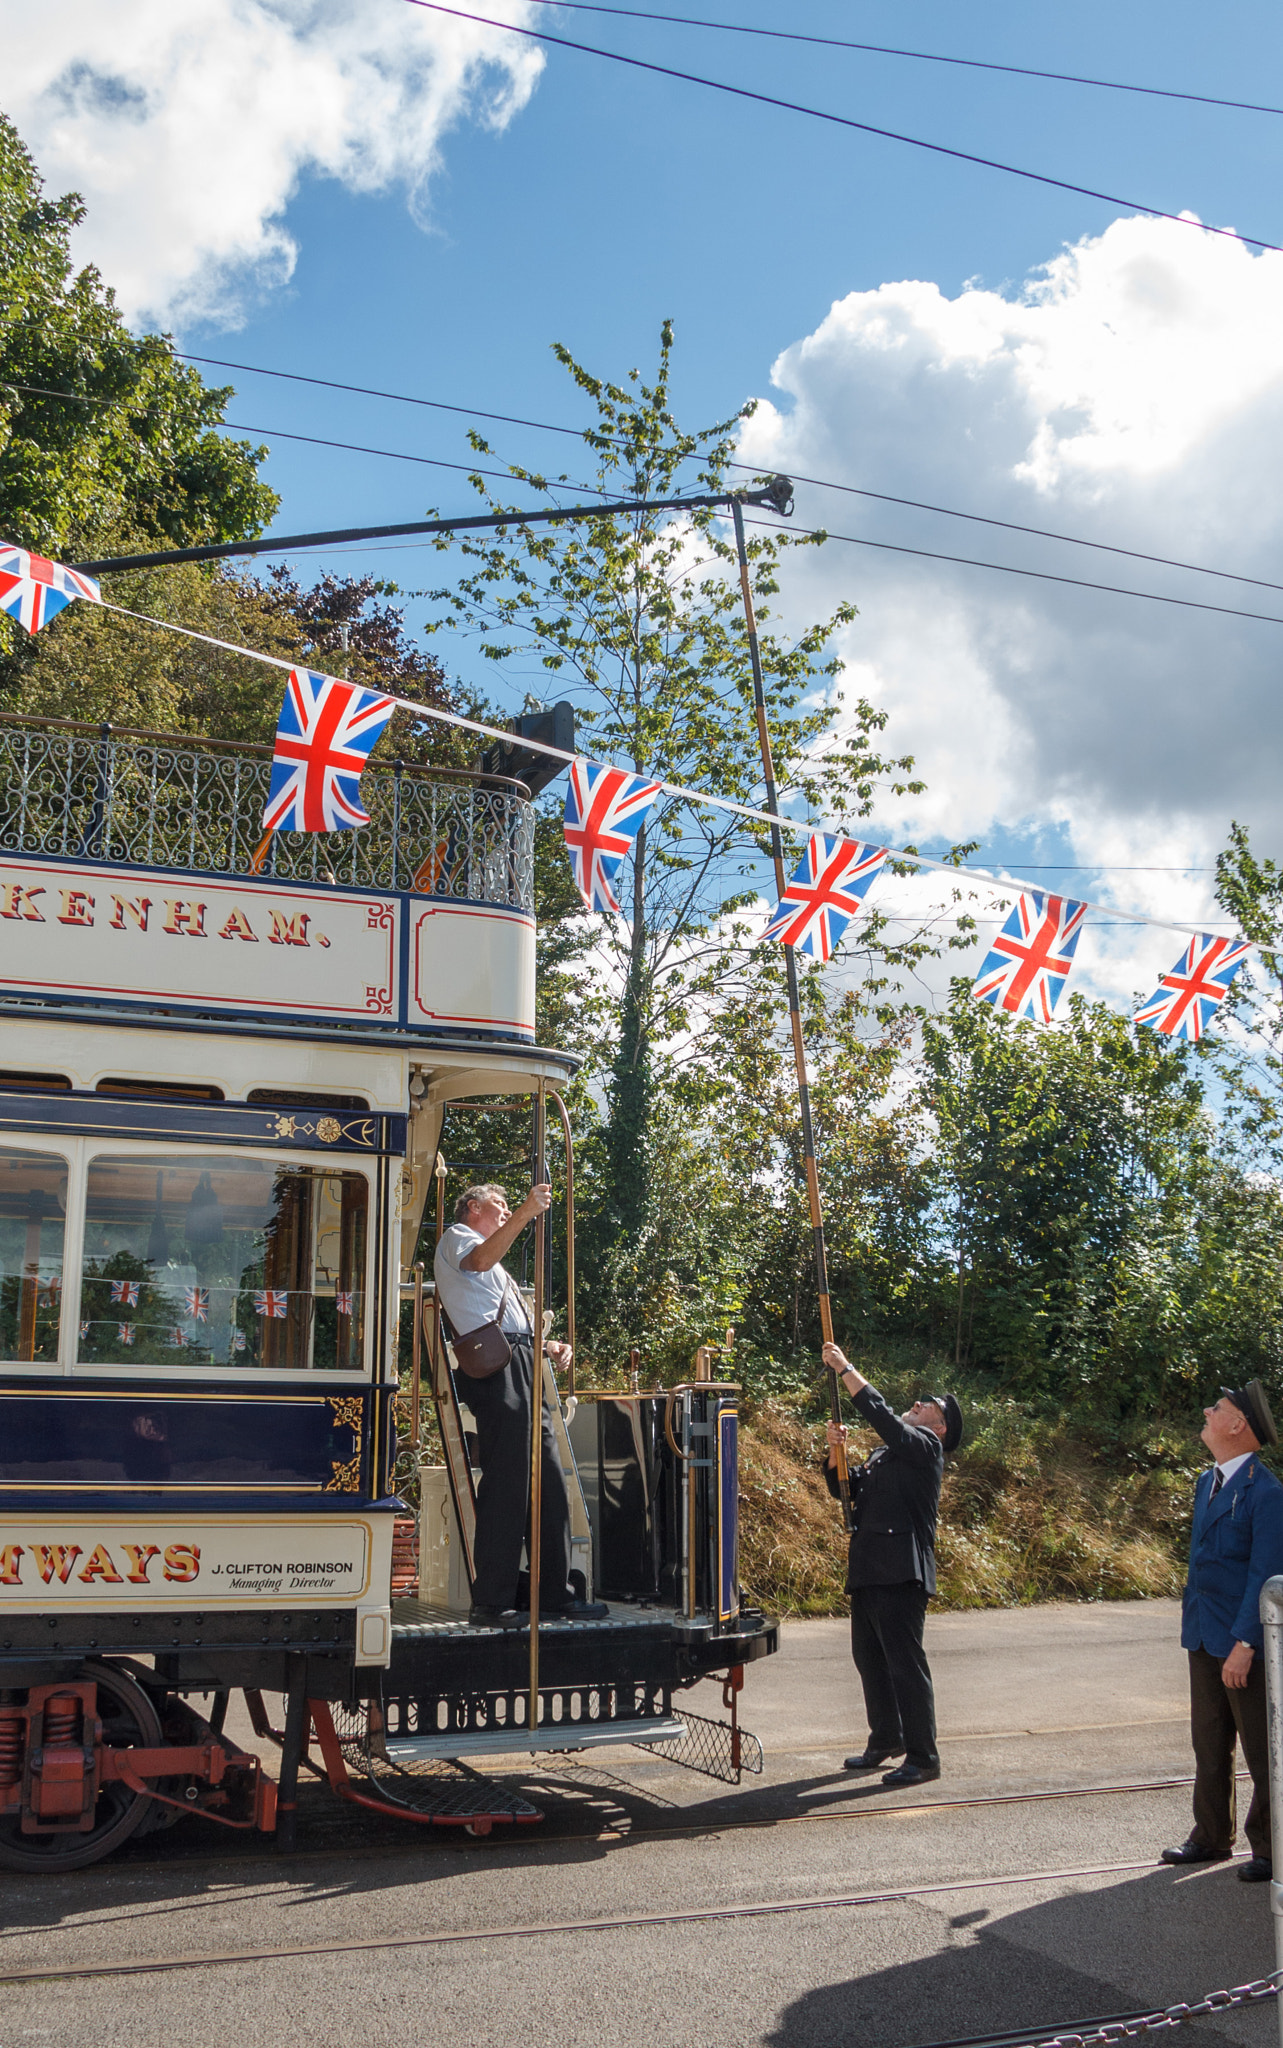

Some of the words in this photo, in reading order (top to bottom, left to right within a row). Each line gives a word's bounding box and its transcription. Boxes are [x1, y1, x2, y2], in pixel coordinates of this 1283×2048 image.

[286, 1562, 353, 1574] ROBINSON
[229, 1577, 283, 1592] Managing
[289, 1577, 336, 1588] Director
